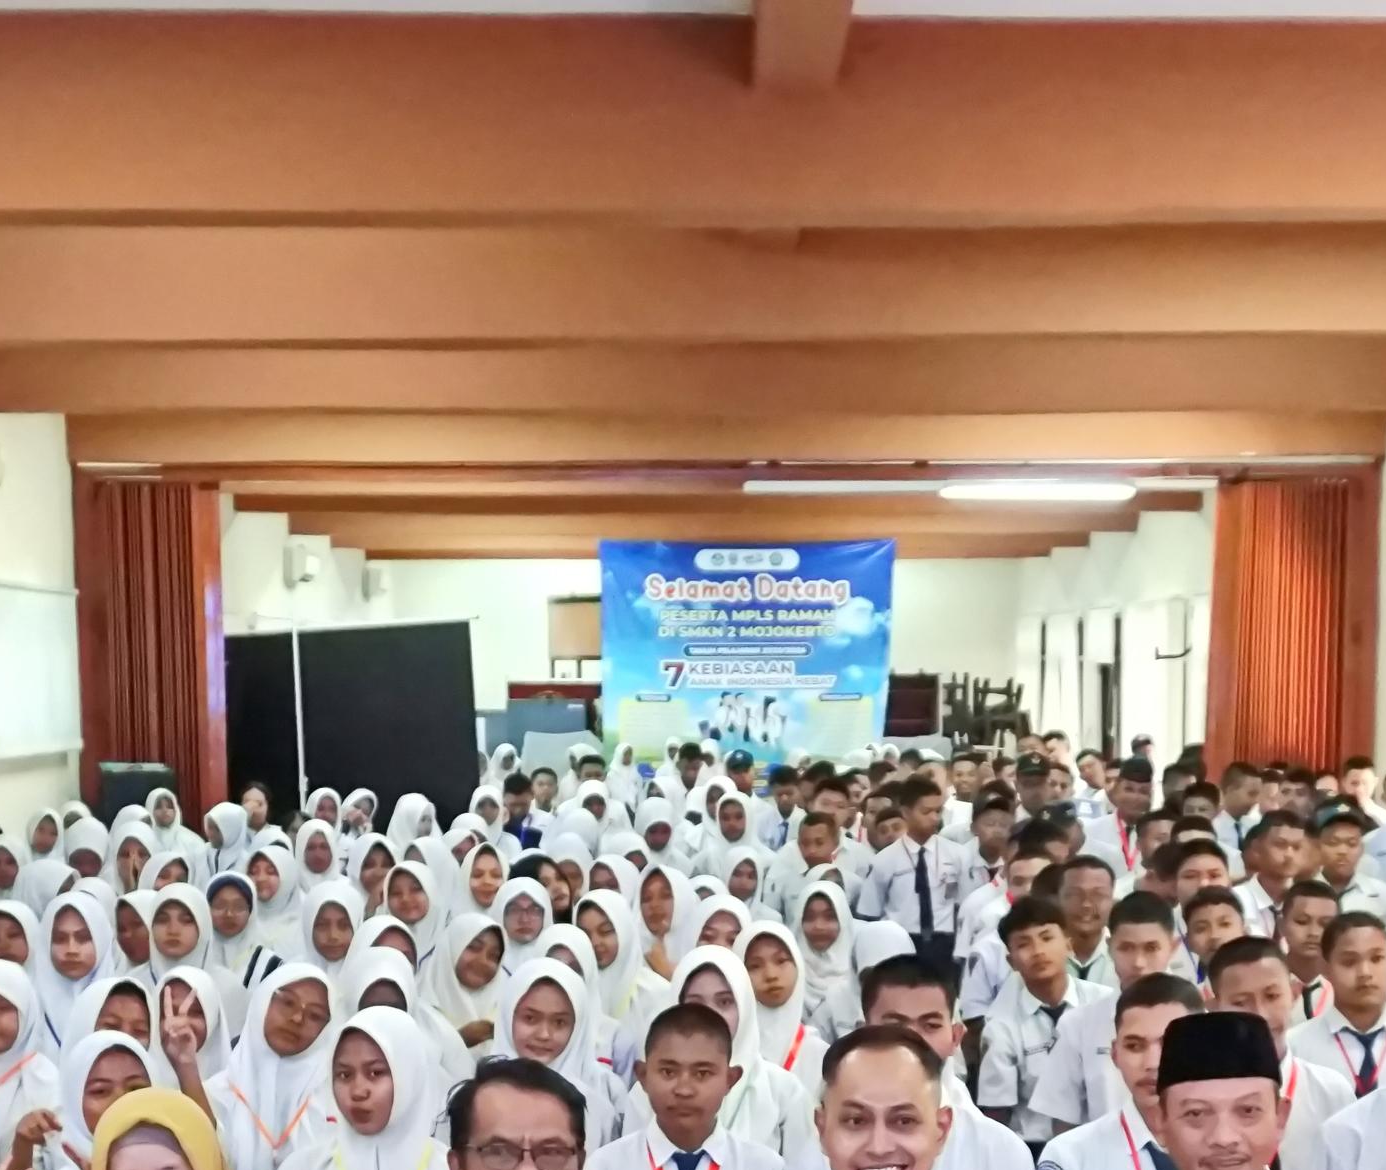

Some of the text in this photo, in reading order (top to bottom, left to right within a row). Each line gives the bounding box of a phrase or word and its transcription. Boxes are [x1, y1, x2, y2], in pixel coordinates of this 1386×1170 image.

[646, 574, 849, 604] Selamat Datang
[660, 609, 835, 621] PESERTA MPLS RAMAH
[658, 626, 836, 637] DI SMKN 2 MOJOKERTO
[663, 662, 685, 687] 7
[689, 662, 793, 675] KEBIASAAN
